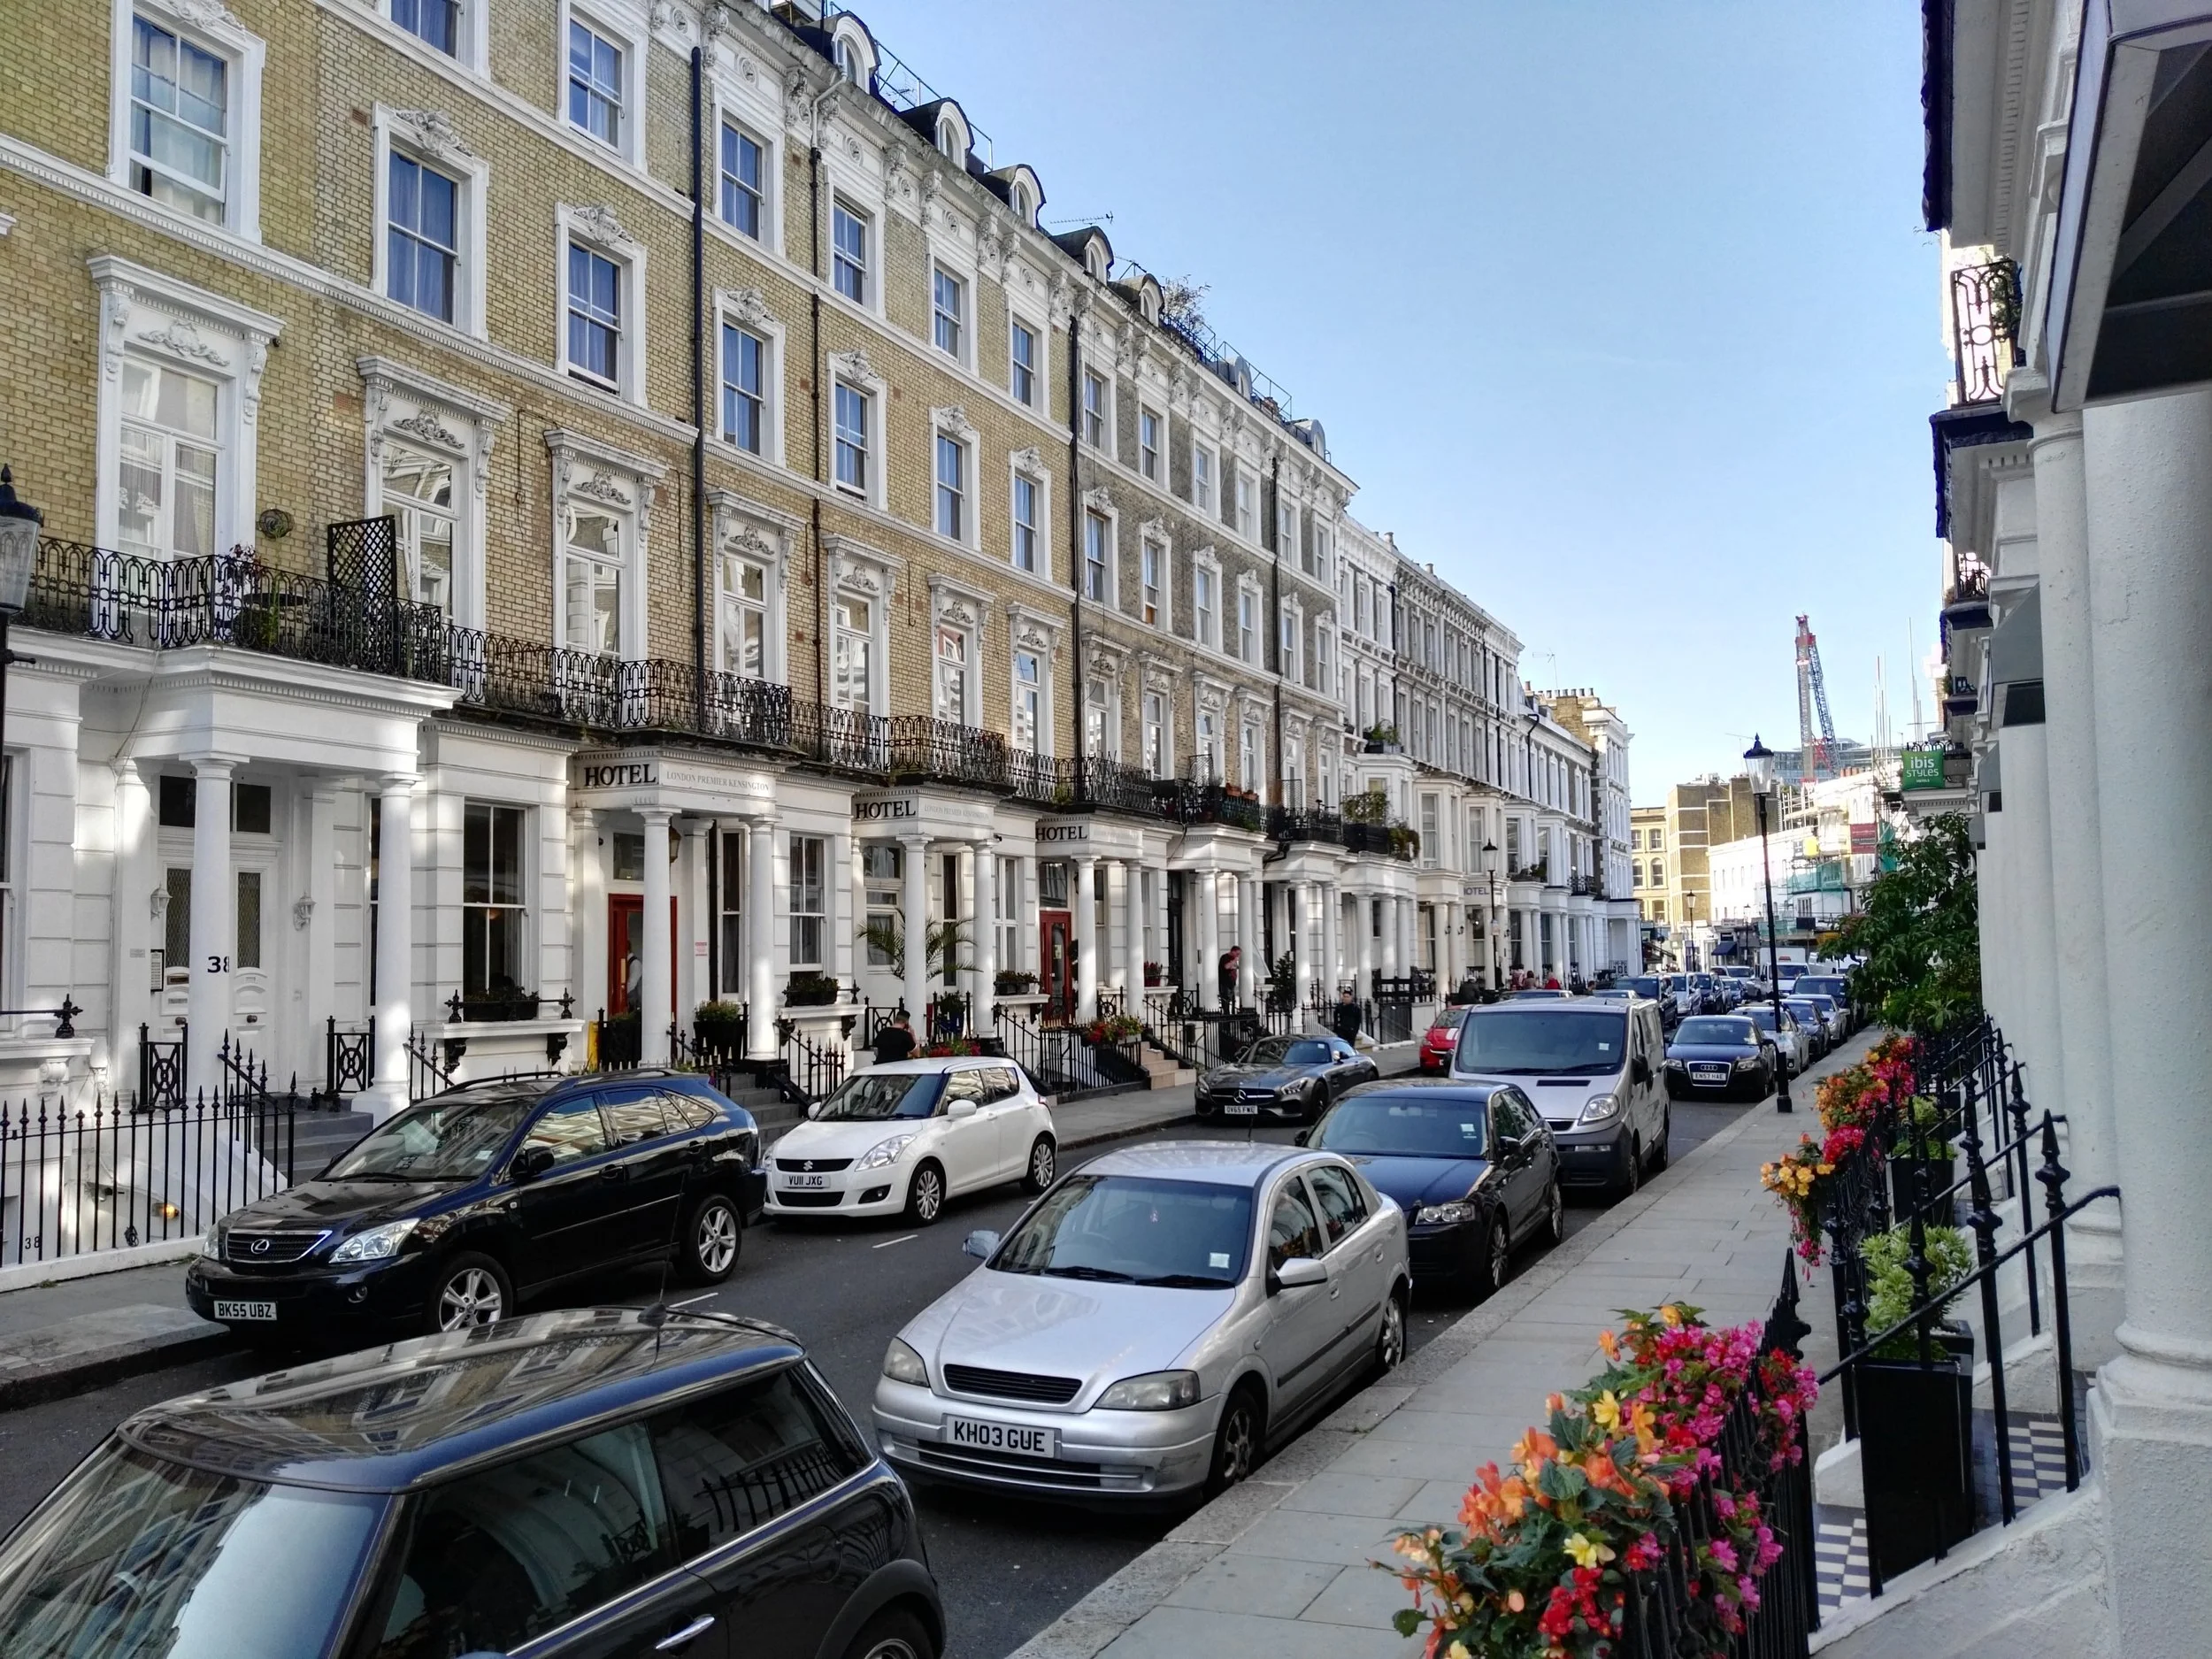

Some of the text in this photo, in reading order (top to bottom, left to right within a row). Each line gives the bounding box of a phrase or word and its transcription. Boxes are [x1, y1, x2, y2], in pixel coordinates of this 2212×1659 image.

[1910, 756, 1935, 769] ibis
[584, 764, 657, 787] HOTEL
[666, 771, 770, 792] LONDON PREMIER KENSINGTON
[855, 800, 917, 819] HOTEL
[1035, 826, 1088, 841] HOTEL
[788, 1175, 823, 1186] VU11 JXG
[25, 1235, 41, 1249] 38
[218, 1302, 273, 1317] BK55 UBZ
[954, 1420, 1045, 1453] KH03 GUE
